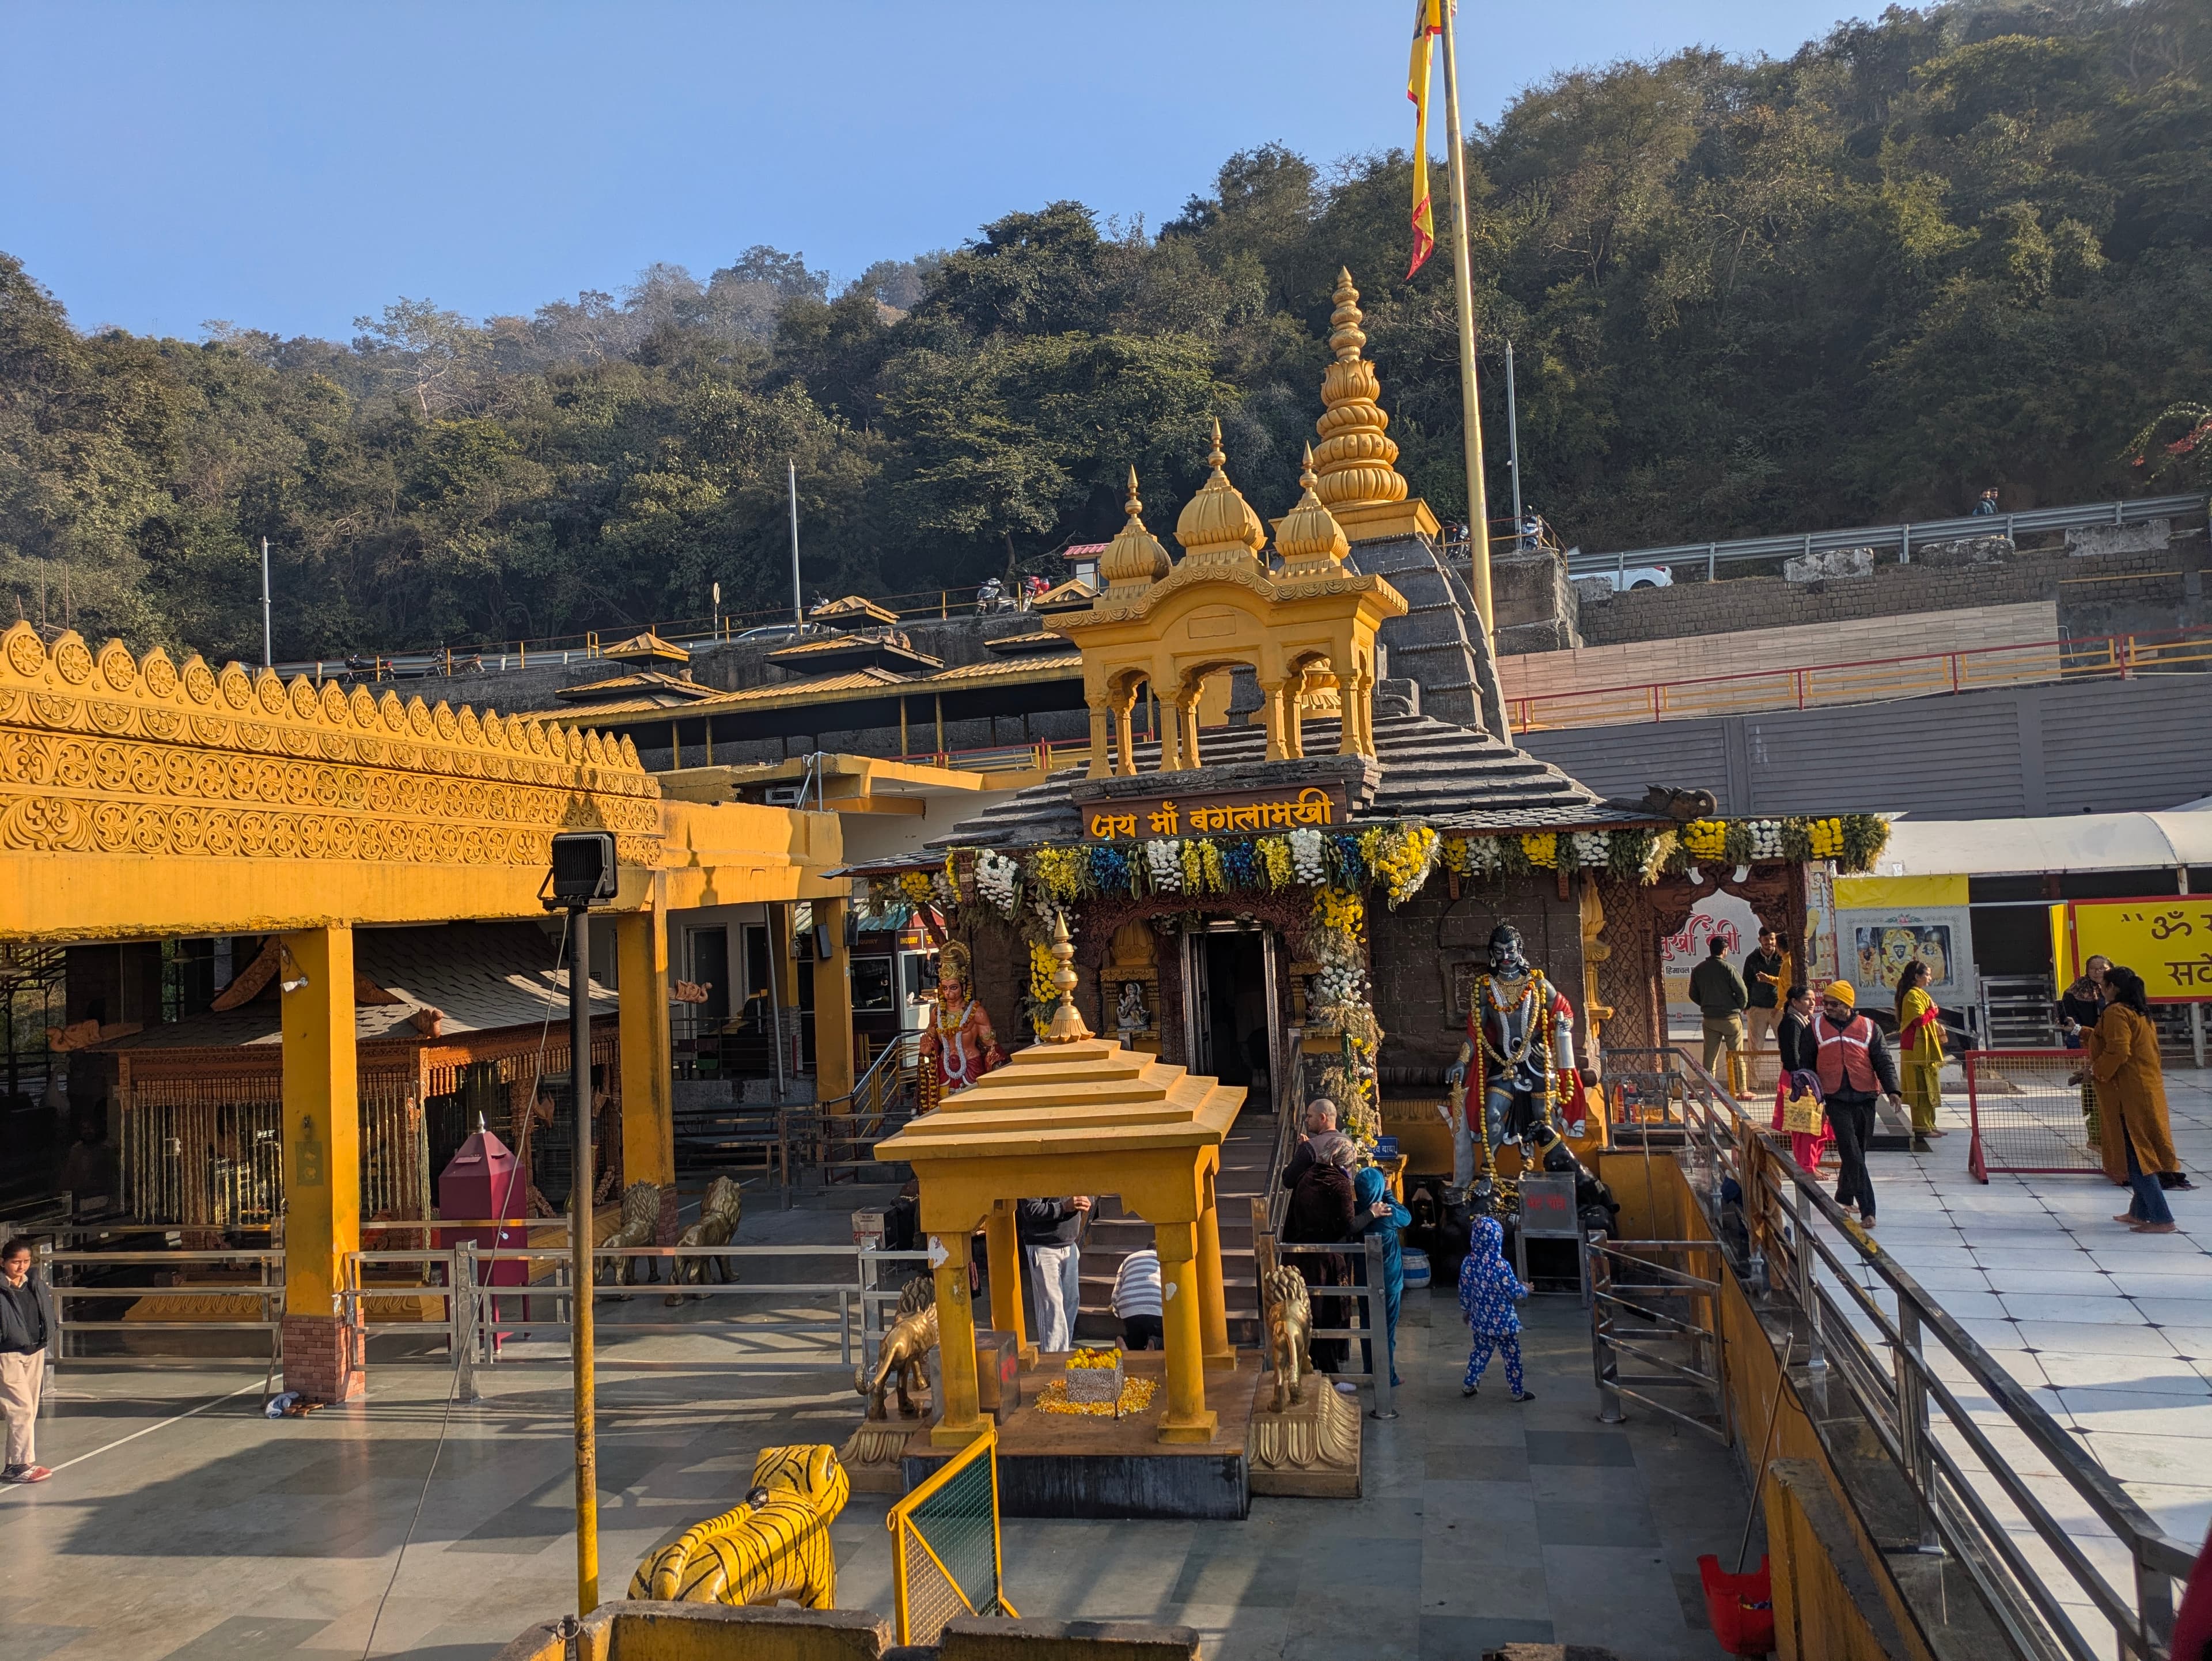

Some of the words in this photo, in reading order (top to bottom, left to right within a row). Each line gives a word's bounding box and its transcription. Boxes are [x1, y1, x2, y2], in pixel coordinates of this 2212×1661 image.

[1090, 813, 1138, 839] जय
[1147, 801, 1180, 835] माँ
[1190, 787, 1335, 831] बगलामुखी
[900, 936, 918, 945] INQUIRY
[1665, 966, 1690, 974] हिमाचल
